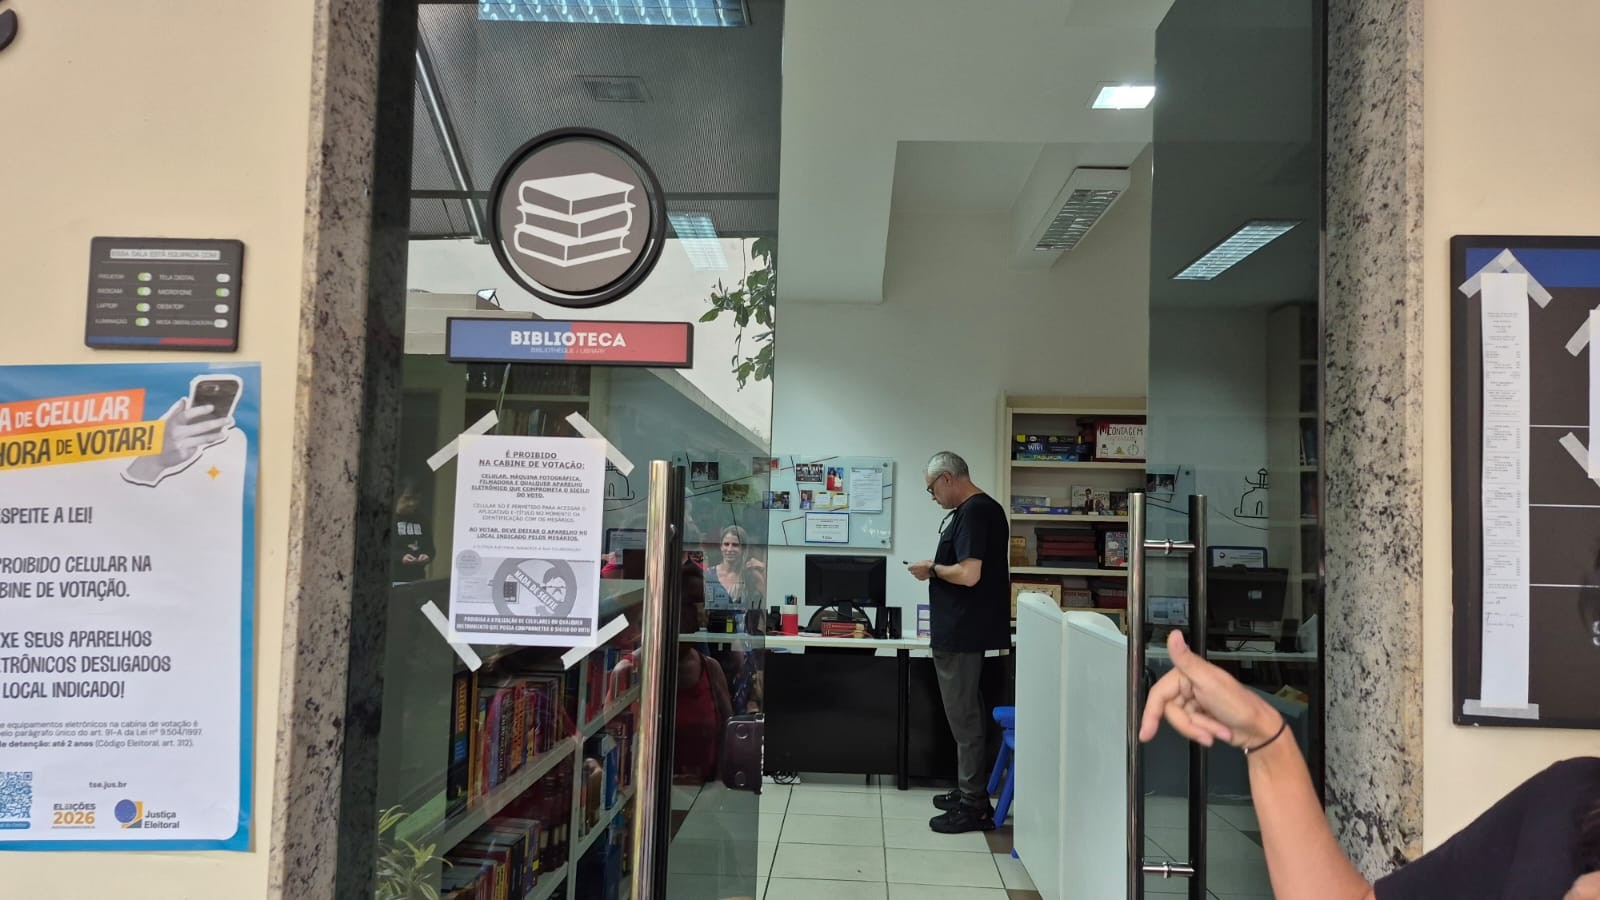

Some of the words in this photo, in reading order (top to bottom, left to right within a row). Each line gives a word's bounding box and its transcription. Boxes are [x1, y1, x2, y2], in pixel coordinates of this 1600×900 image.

[510, 330, 626, 347] BIBLIOTECA
[16, 412, 32, 428] DE
[36, 396, 131, 426] CELULAR
[56, 440, 72, 456] DE
[76, 425, 154, 455] VOTAR!
[505, 449, 510, 458] É
[542, 460, 585, 469] VOTAÇÃO:
[0, 508, 49, 524] SPEITE
[54, 508, 64, 523] A
[68, 506, 93, 524] LEI!
[65, 555, 127, 573] CELULAR
[132, 555, 152, 572] NA
[36, 582, 54, 598] DE
[59, 579, 130, 601] VOTAÇÃO.
[514, 570, 531, 588] NADA
[530, 583, 539, 595] DE
[537, 591, 559, 610] SELFIE
[24, 631, 64, 648] SEUS
[69, 630, 152, 648] APARELHOS
[0, 654, 76, 674] TRÔNICOS
[81, 655, 171, 673] DESLIGADOS
[3, 682, 47, 699] LOCAL
[52, 681, 125, 699] INDICADO!
[160, 720, 192, 729] votação
[15, 729, 54, 738] parágrafo
[89, 781, 127, 790] tse.jus.br
[53, 811, 95, 825] 2026
[144, 811, 176, 820] Justiça
[144, 821, 180, 829] Eleitoral
